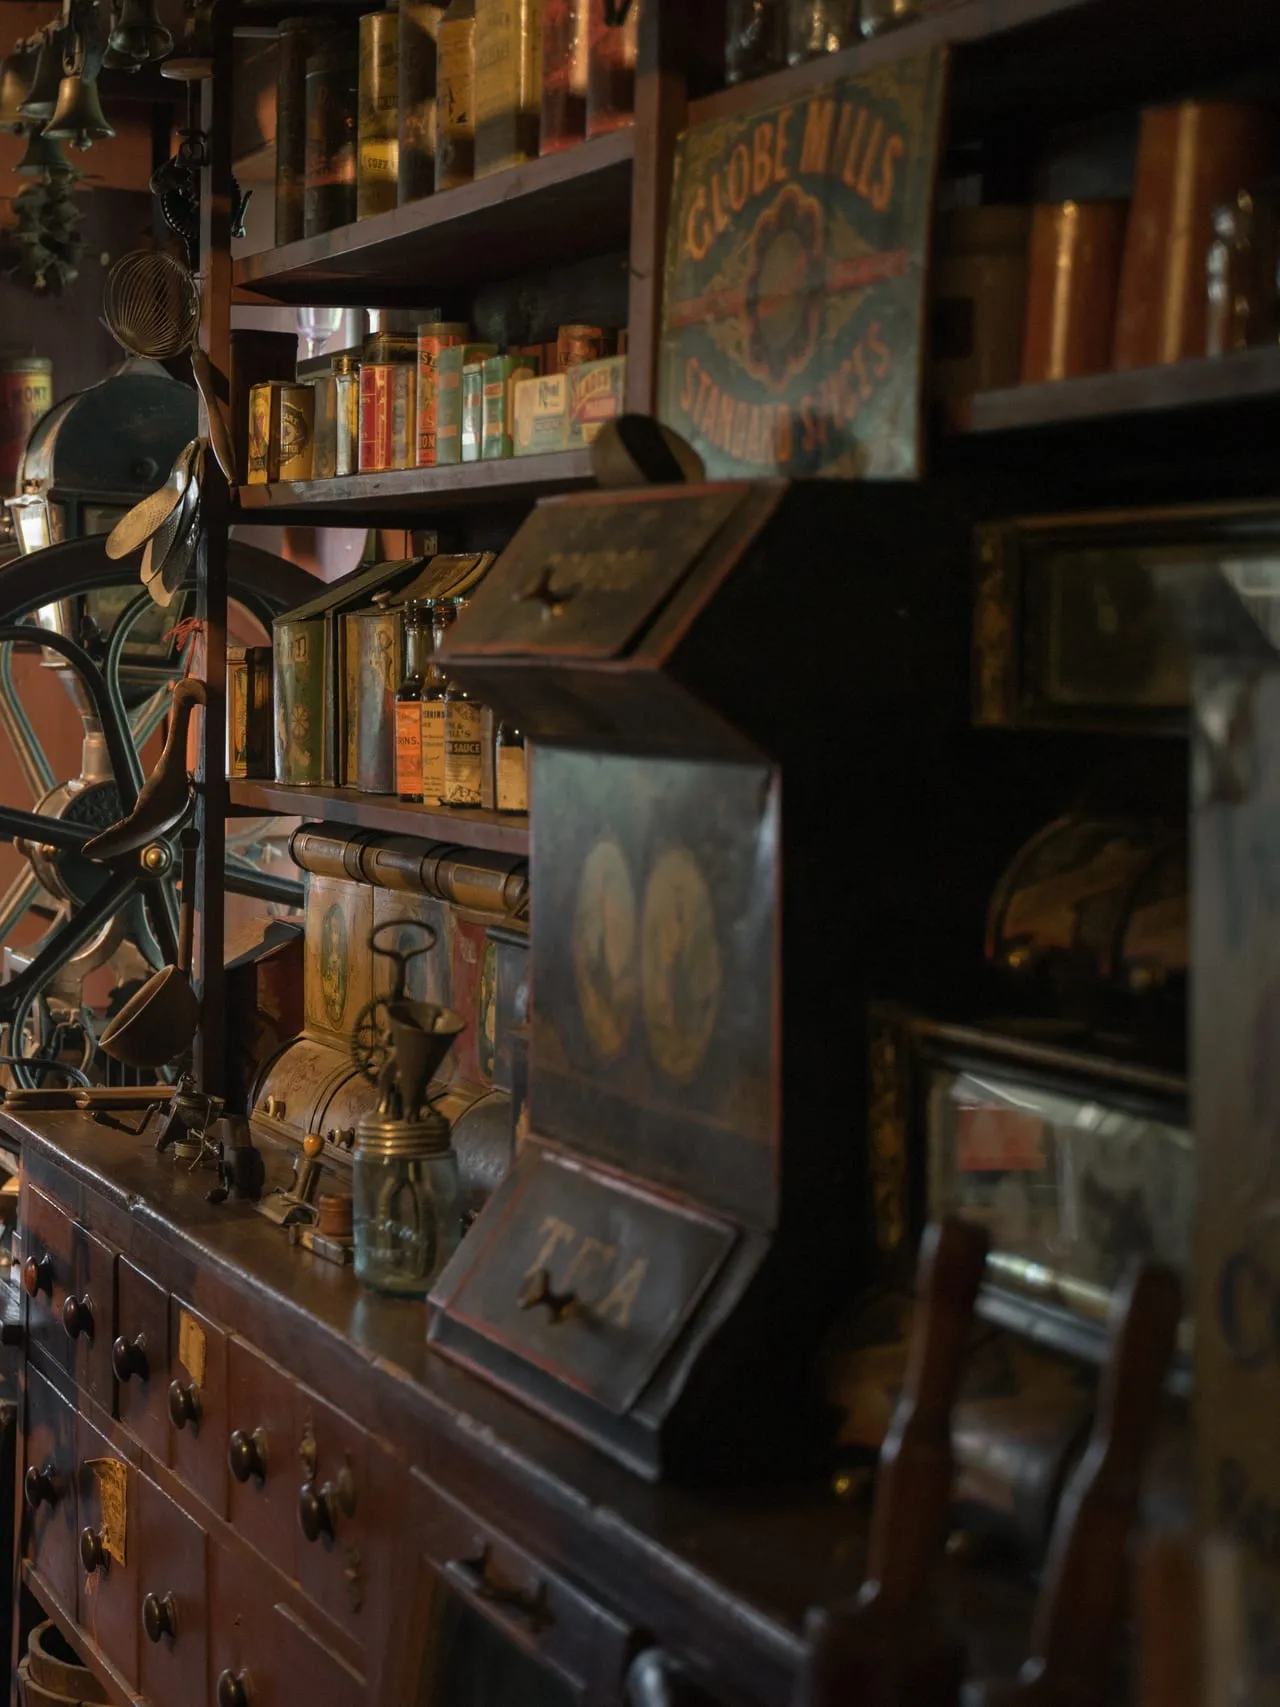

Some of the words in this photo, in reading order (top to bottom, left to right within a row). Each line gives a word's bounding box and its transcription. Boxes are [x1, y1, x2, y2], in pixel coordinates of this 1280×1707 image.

[686, 108, 793, 262] GLOBE
[799, 99, 904, 213] MILLS
[680, 356, 792, 463] STANDARD
[453, 743, 480, 753] SAUCE
